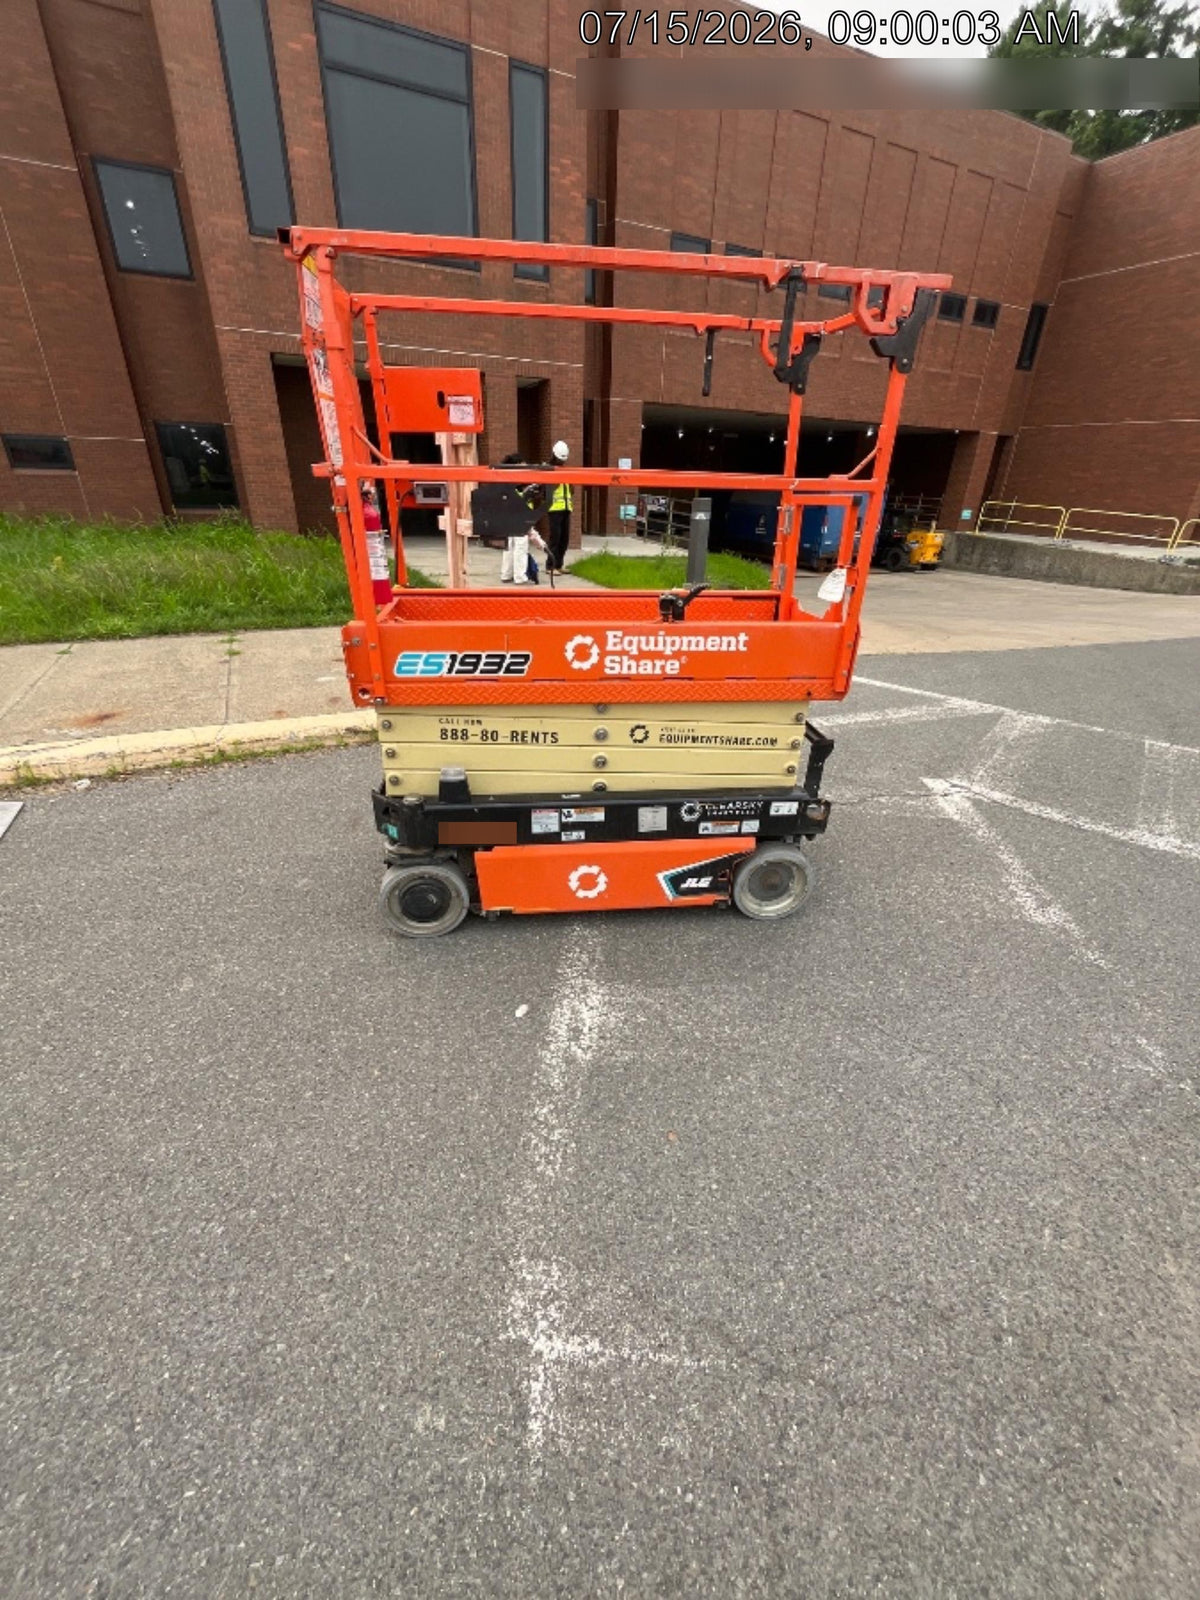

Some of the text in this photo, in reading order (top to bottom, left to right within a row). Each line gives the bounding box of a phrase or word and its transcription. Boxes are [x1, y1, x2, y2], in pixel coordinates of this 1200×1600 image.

[606, 630, 749, 655] Equipment
[394, 651, 532, 677] ES1932
[659, 733, 778, 747] EQUIPMENTSHARE.COM
